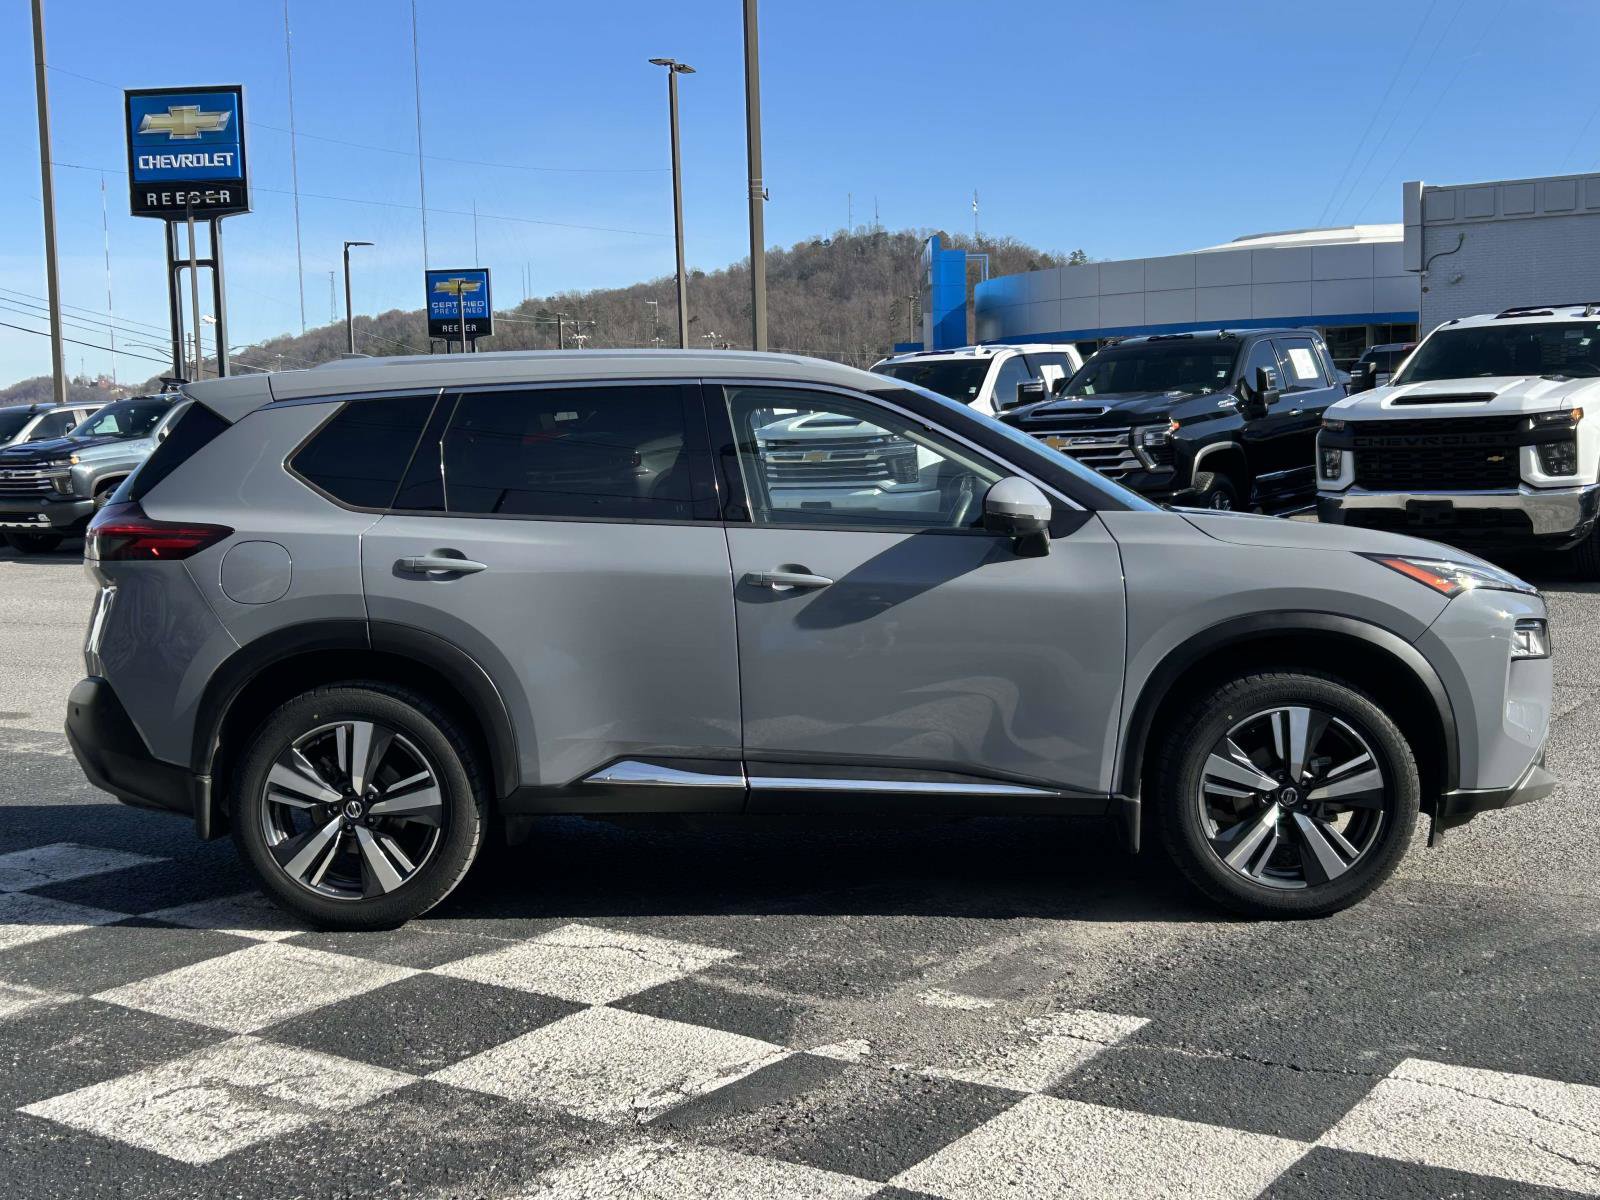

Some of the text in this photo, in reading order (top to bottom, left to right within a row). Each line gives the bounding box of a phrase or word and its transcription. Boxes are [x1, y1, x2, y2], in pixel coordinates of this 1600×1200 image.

[138, 152, 234, 169] CHEVROLET
[442, 324, 477, 332] REEER
[1353, 434, 1514, 447] CHEVROLET
